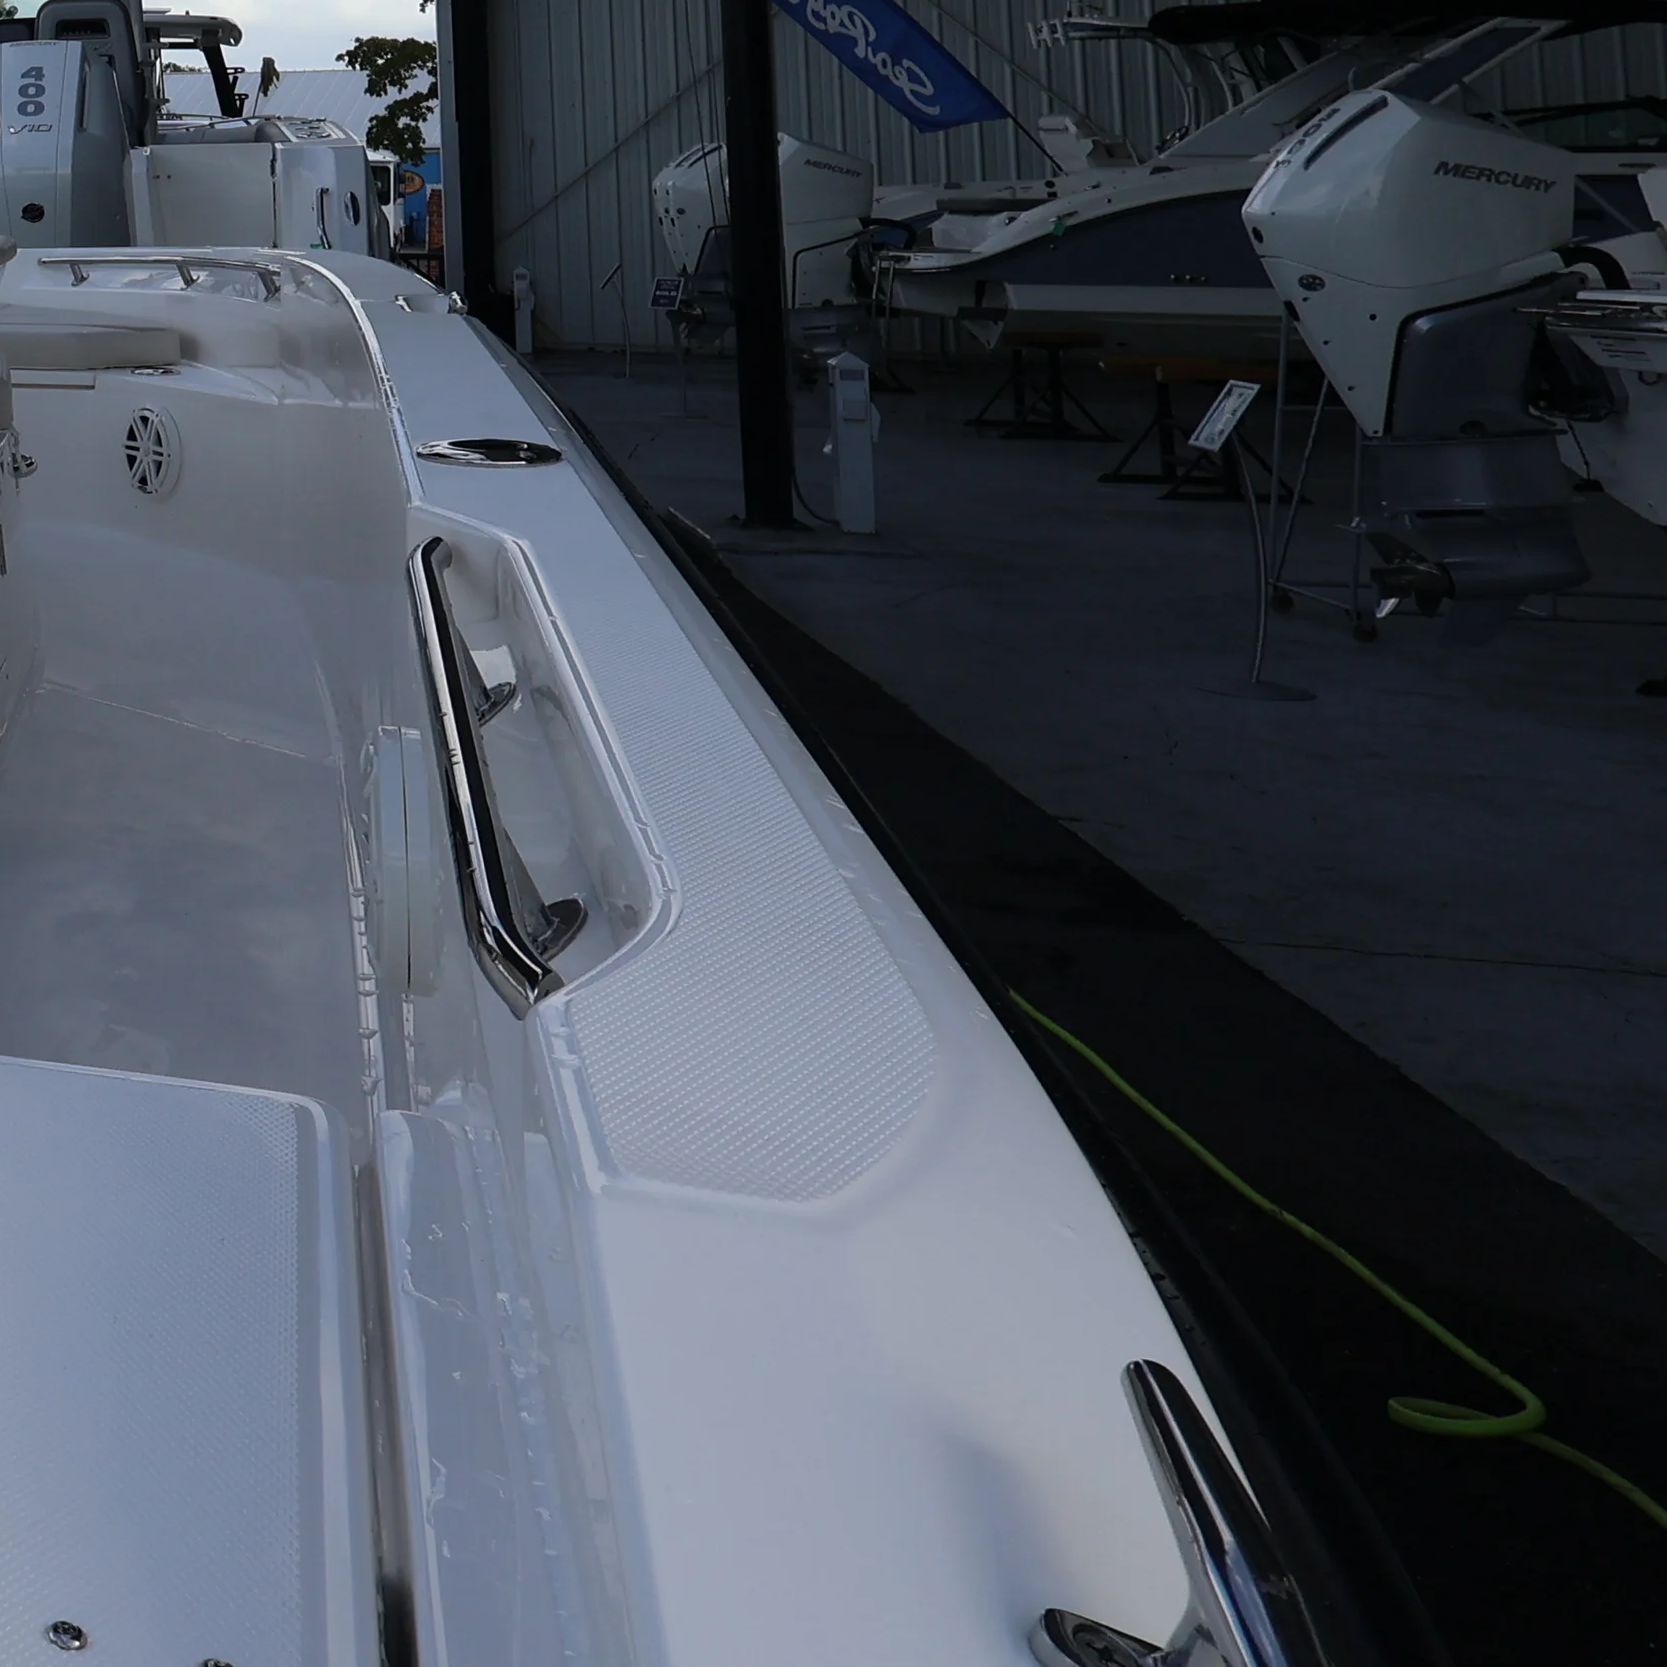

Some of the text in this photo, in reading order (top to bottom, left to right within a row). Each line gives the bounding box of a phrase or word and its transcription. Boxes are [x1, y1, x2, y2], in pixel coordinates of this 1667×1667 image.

[17, 66, 46, 117] 400
[7, 123, 53, 135] V10
[804, 158, 863, 178] MERCURY
[1433, 160, 1557, 194] MERCURY
